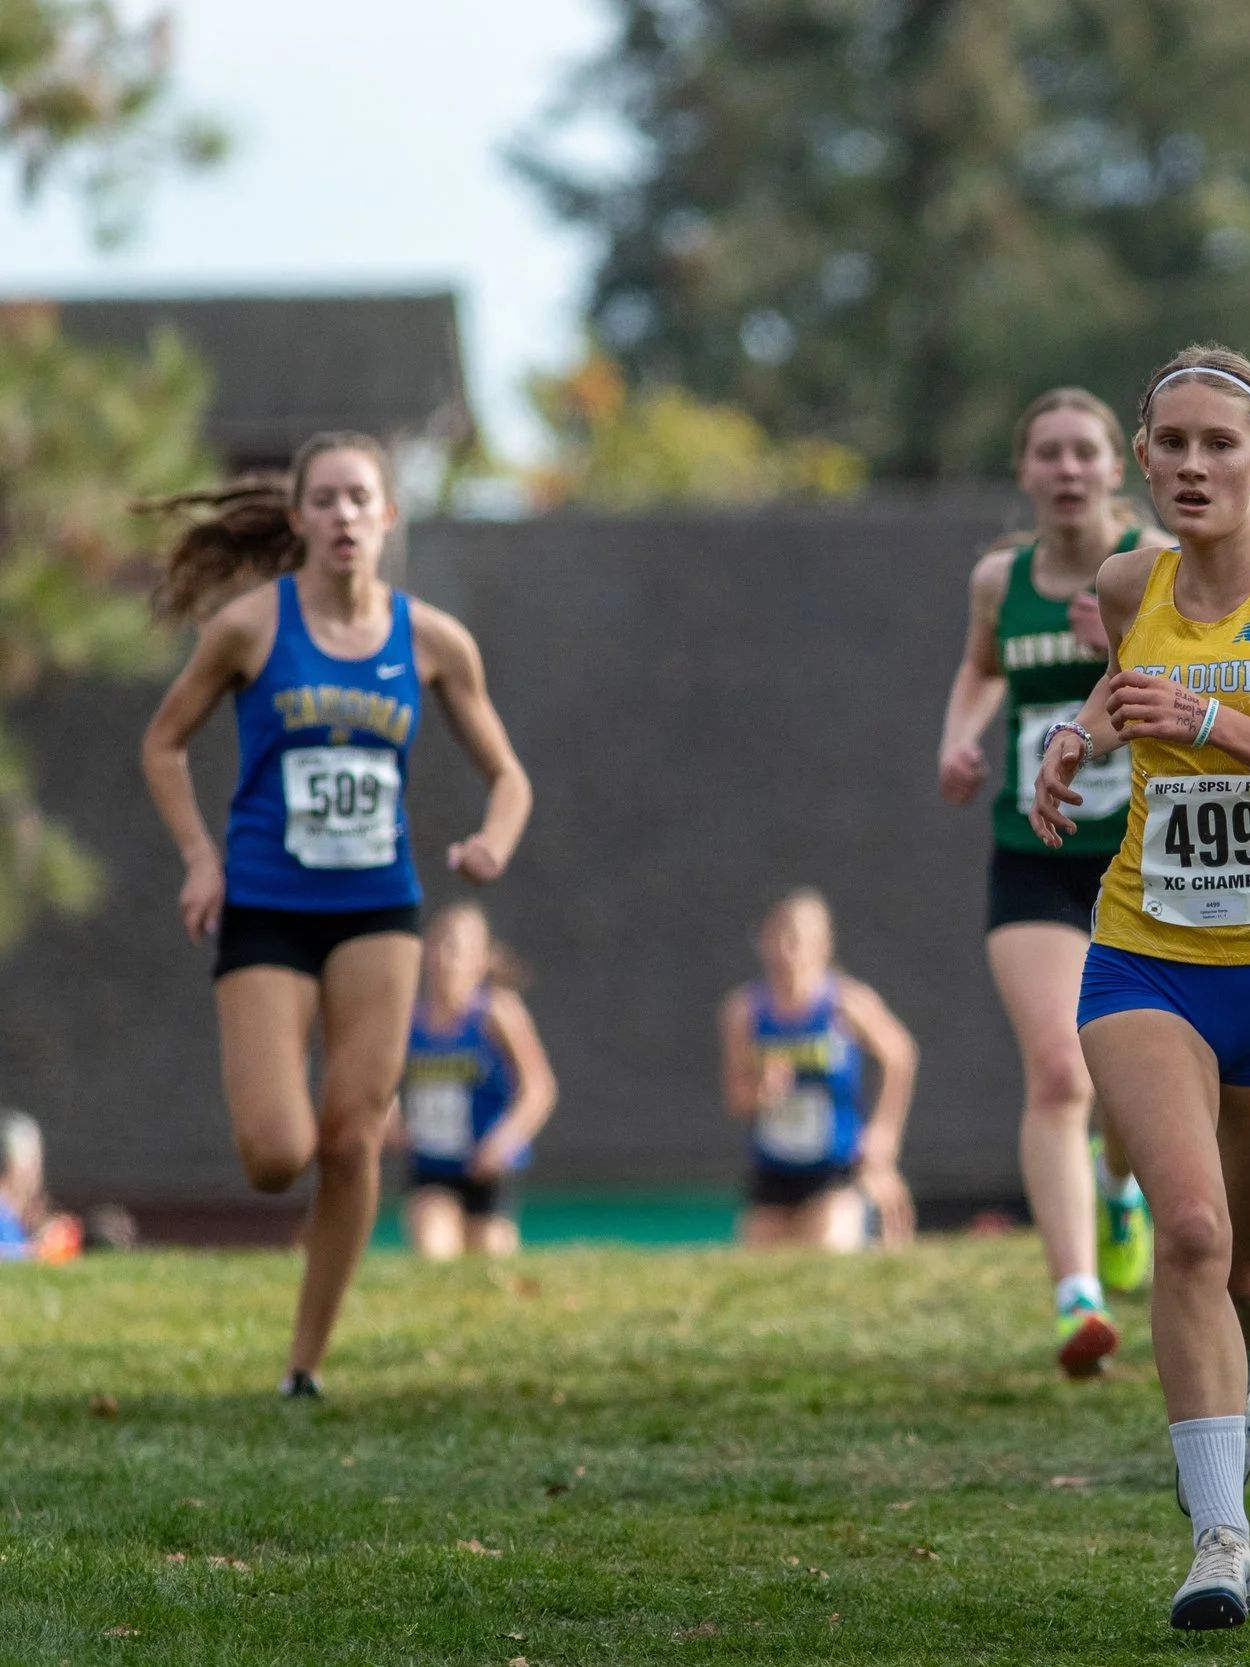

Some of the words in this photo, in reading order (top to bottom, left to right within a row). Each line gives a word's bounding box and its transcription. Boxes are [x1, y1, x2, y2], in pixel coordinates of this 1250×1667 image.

[309, 770, 380, 819] 509
[1155, 782, 1187, 794] NPSL
[1198, 781, 1232, 793] SPSL
[1164, 876, 1186, 890] XC
